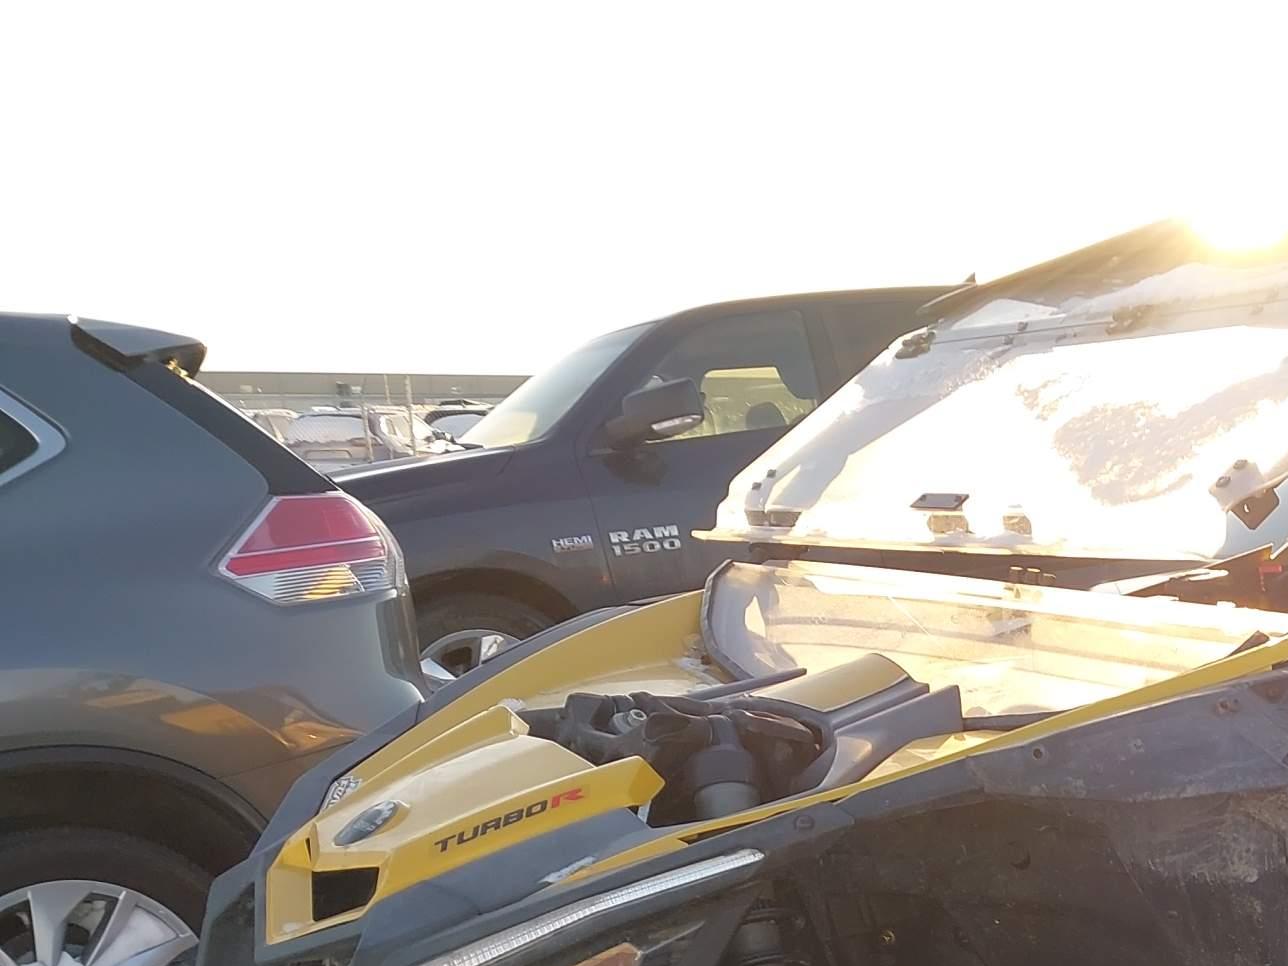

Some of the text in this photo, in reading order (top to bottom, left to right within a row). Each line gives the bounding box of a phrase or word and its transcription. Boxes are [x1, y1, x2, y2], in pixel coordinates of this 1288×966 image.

[551, 535, 593, 547] HEMI
[608, 525, 680, 543] RAM
[612, 538, 682, 557] 1500
